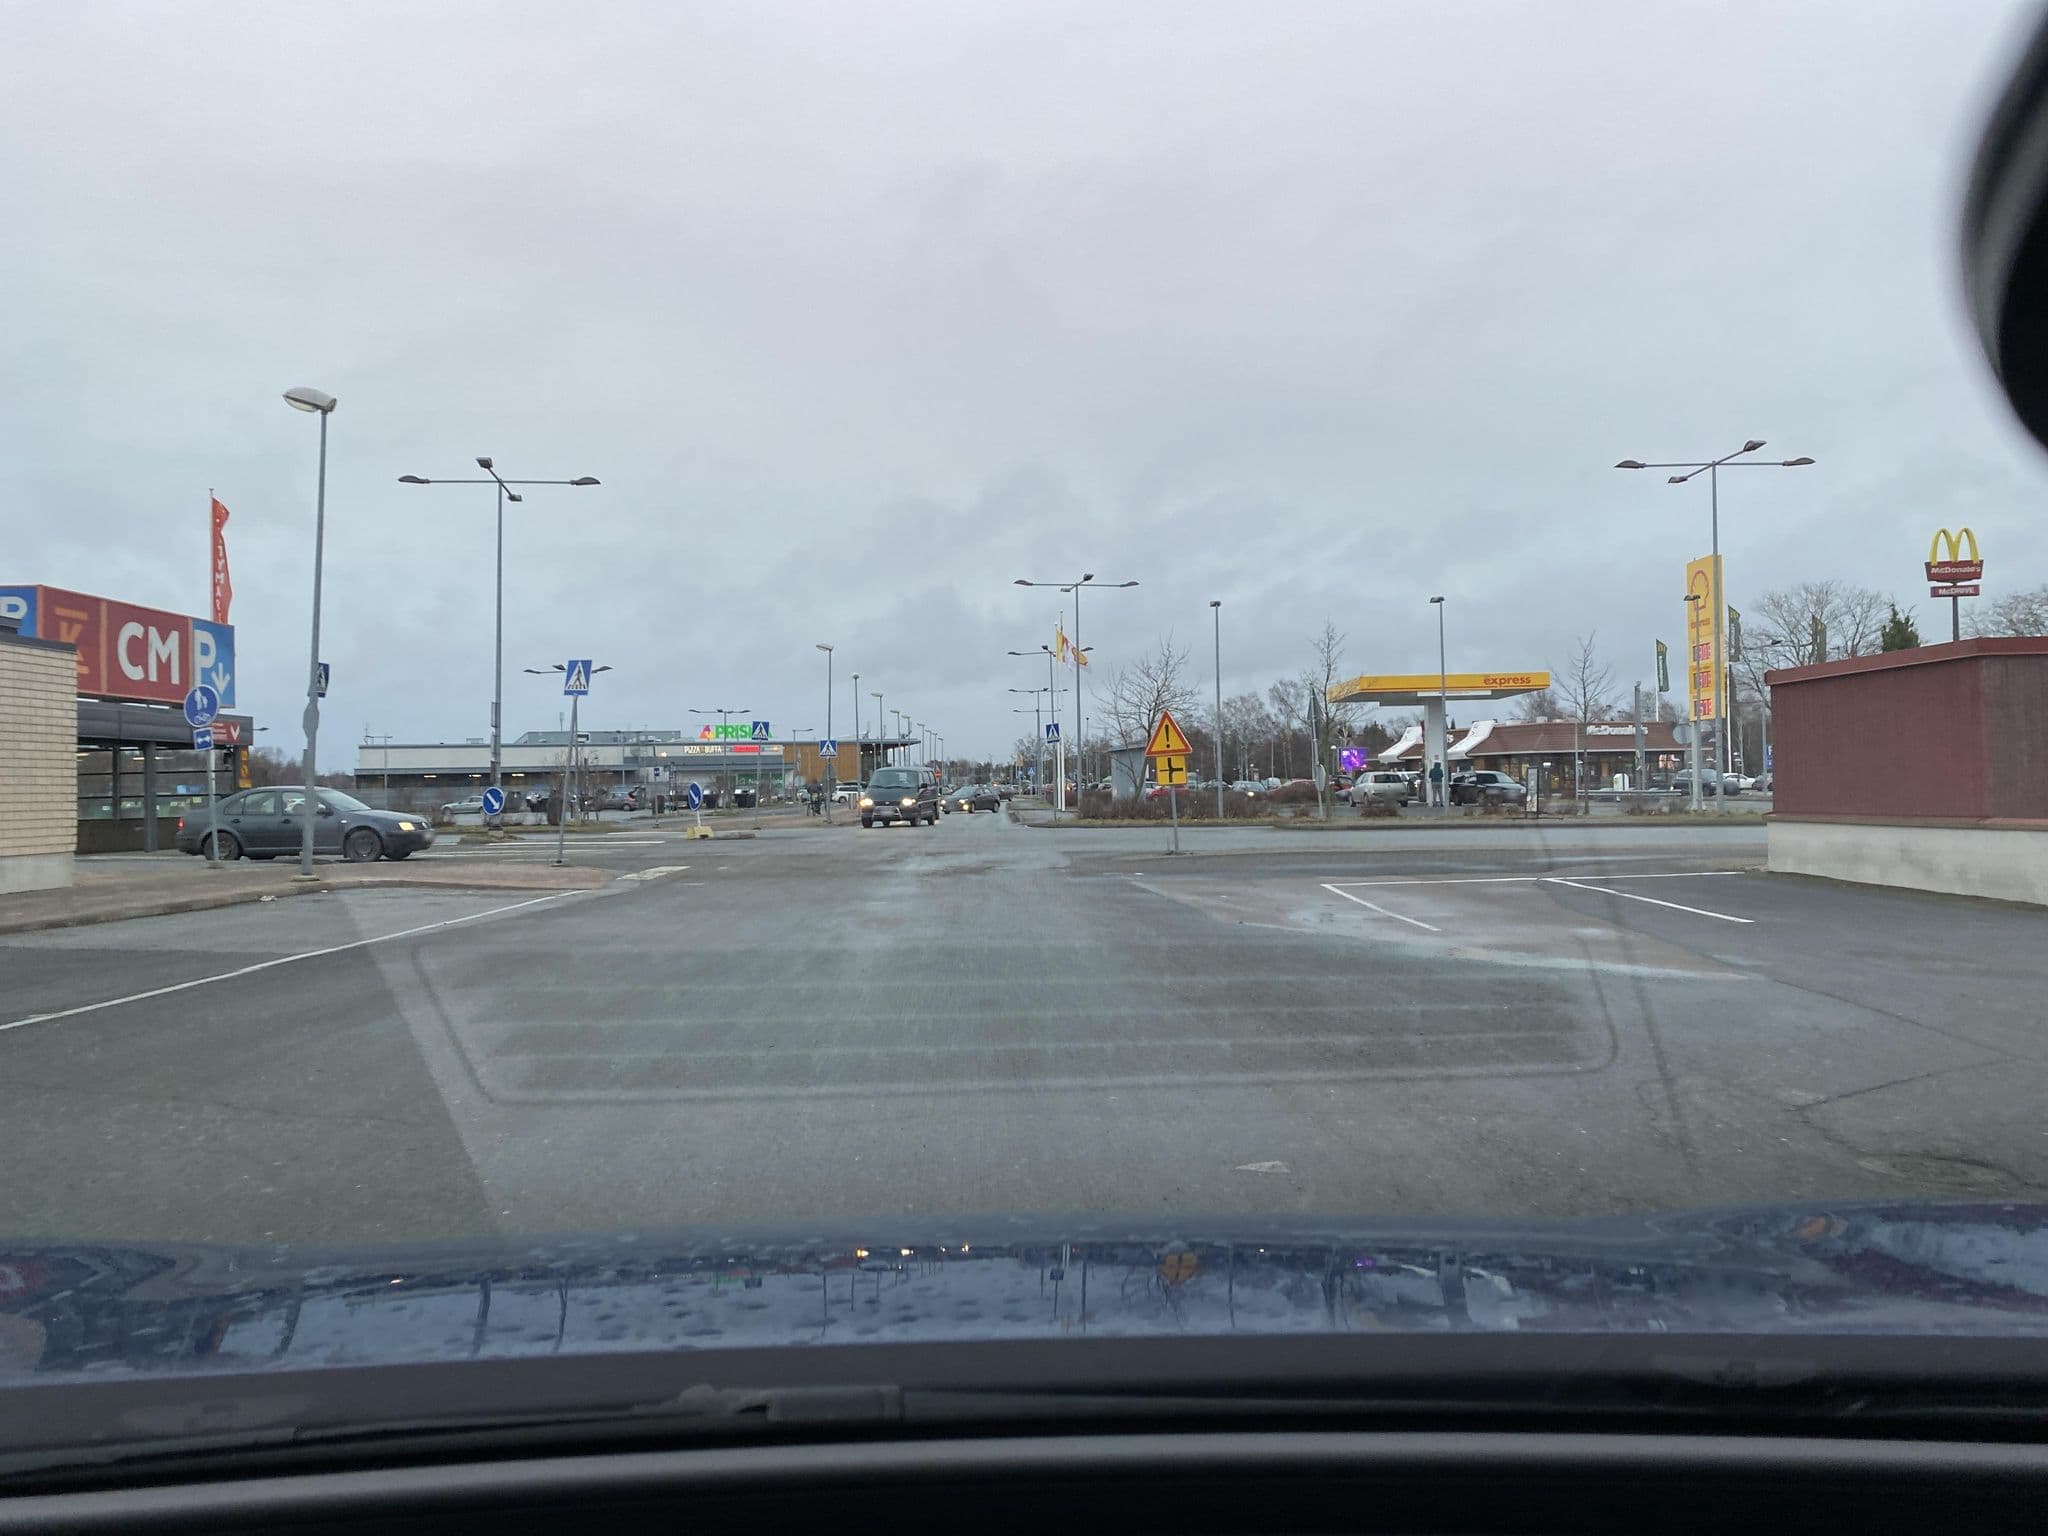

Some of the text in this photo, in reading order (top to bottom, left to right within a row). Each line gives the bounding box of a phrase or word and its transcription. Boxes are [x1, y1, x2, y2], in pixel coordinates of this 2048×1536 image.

[117, 621, 181, 685] CM
[193, 629, 217, 687] P
[1483, 675, 1532, 686] express
[715, 724, 774, 739] PRIS
